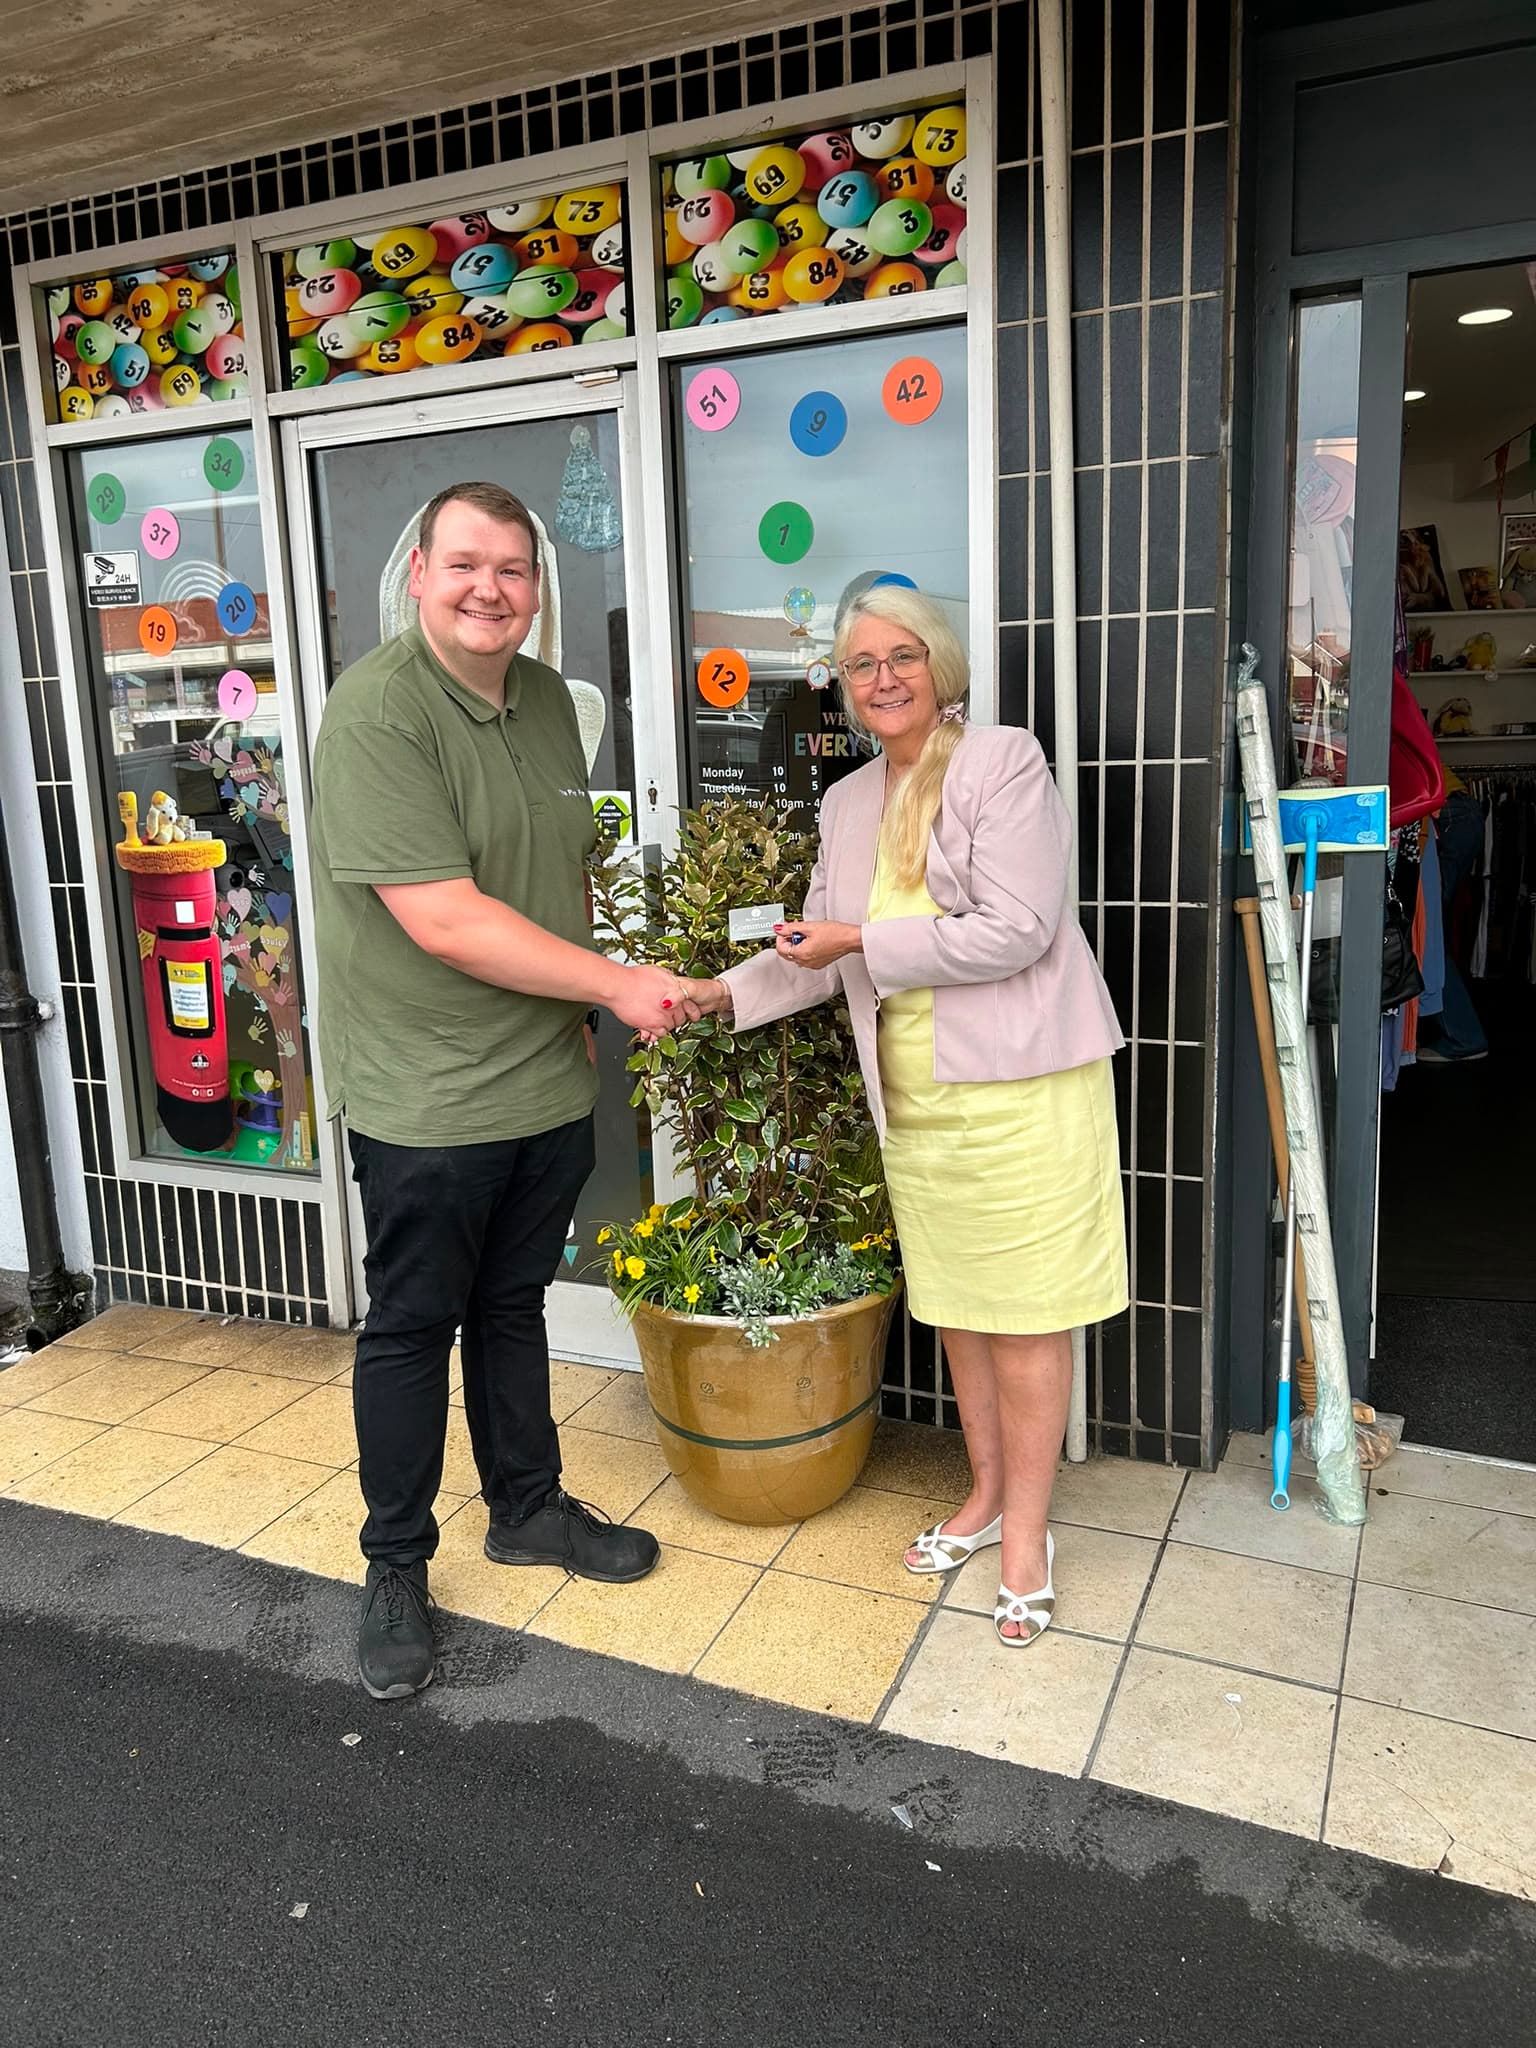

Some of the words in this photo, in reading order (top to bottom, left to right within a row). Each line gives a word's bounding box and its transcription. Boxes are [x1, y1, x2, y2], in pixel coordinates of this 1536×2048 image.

[926, 127, 958, 152] 73
[888, 165, 918, 192] 81
[825, 180, 858, 207] 51
[568, 201, 604, 222] 73
[683, 196, 712, 223] 29
[898, 209, 920, 234] 3
[527, 235, 560, 259] 81
[838, 238, 870, 266] 42
[929, 229, 950, 252] 8
[459, 252, 494, 276] 51
[808, 257, 838, 285] 84
[306, 274, 337, 299] 29
[540, 276, 563, 298] 3
[131, 298, 153, 321] 84
[575, 291, 598, 312] 8
[112, 314, 134, 336] 42
[474, 304, 510, 330] 42
[65, 323, 76, 342] 8
[442, 323, 476, 348] 84
[84, 337, 97, 357] 3
[124, 360, 145, 382] 51
[224, 353, 245, 374] 29
[88, 370, 107, 389] 81
[896, 374, 928, 404] 42
[67, 396, 86, 416] 73
[700, 385, 728, 418] 51
[808, 410, 827, 435] 9
[211, 452, 233, 477] 34
[96, 486, 115, 513] 29
[149, 522, 171, 546] 37
[779, 523, 790, 546] 1
[115, 574, 131, 584] 24H
[226, 594, 247, 623] 20
[147, 621, 166, 642] 19
[711, 663, 737, 693] 12
[231, 687, 243, 706] 7
[794, 732, 860, 757] EVERY
[702, 767, 744, 779] Monday
[772, 766, 784, 776] 10
[810, 765, 818, 775] 5
[704, 783, 747, 795] Tuesday
[774, 783, 787, 793] 10
[811, 781, 819, 790] 5
[775, 798, 804, 808] 10am
